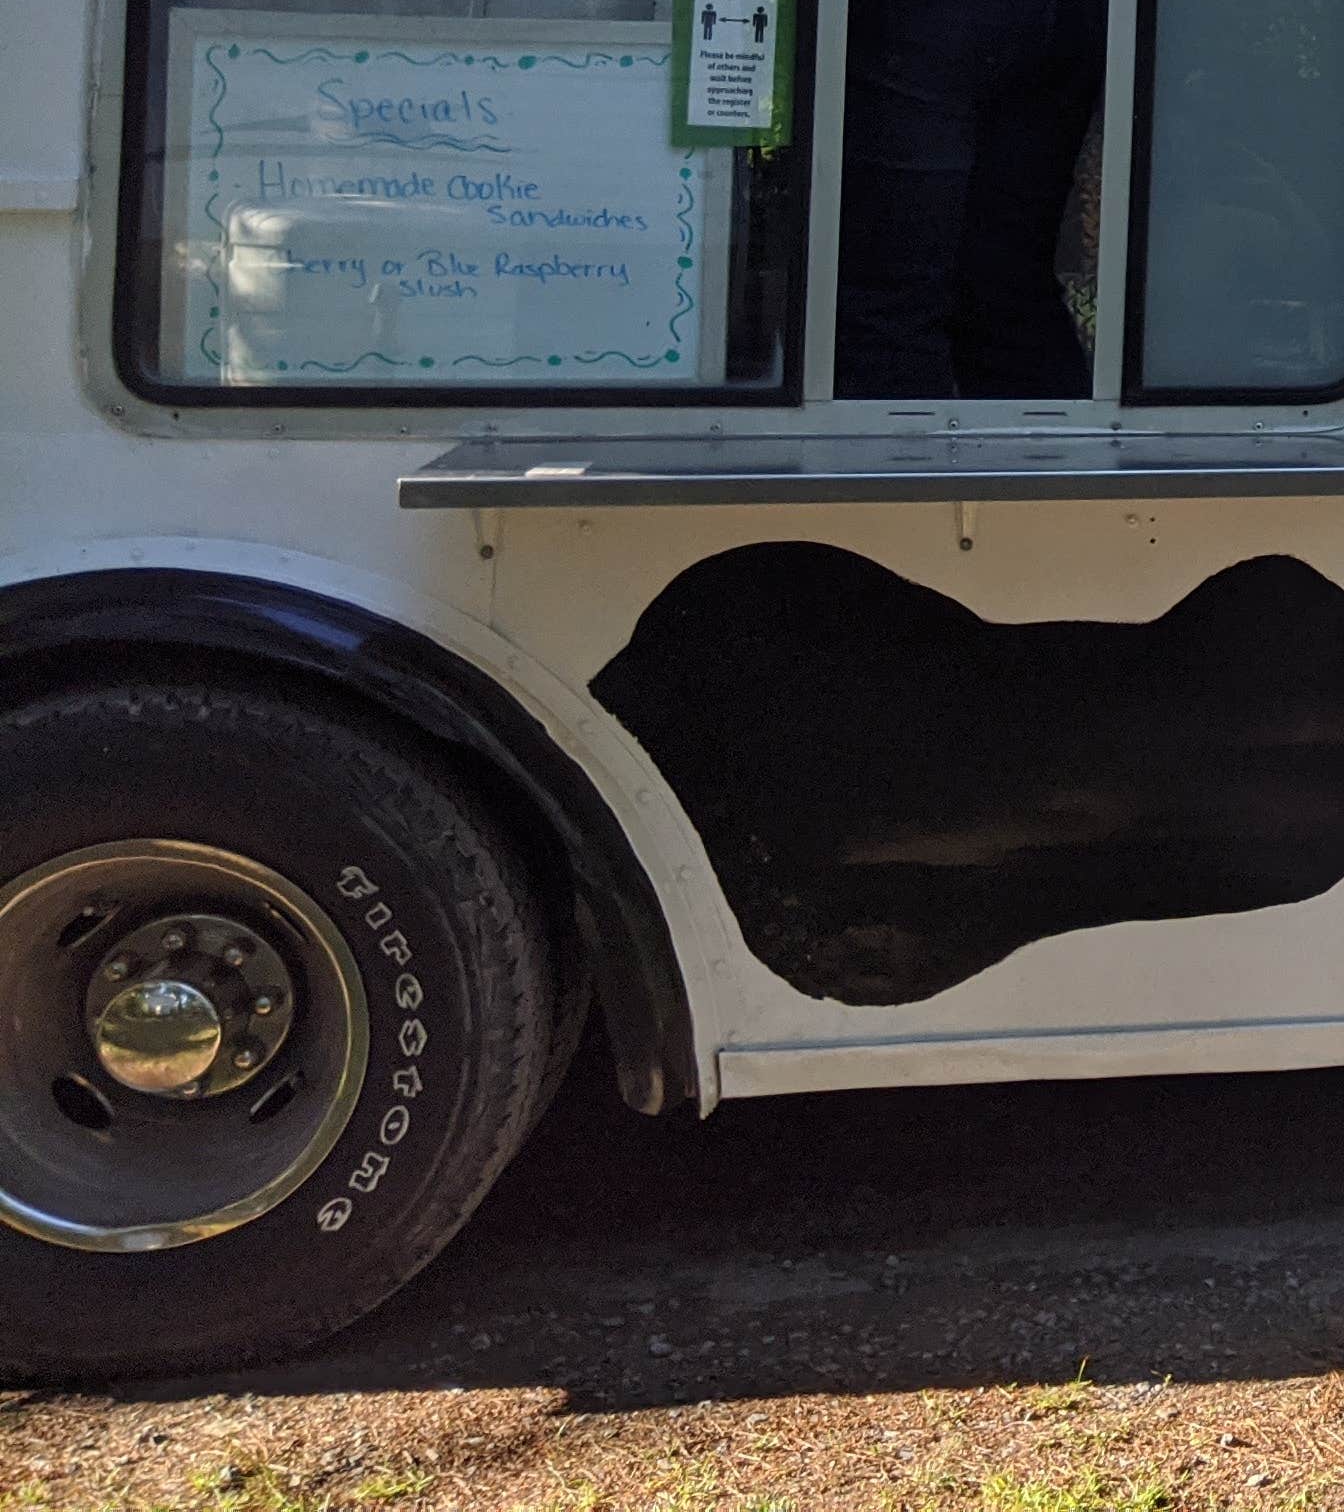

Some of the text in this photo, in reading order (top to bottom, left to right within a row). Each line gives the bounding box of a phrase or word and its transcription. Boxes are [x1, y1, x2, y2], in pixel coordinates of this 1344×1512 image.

[317, 78, 498, 129] Specials
[382, 259, 403, 276] or
[417, 250, 480, 277] Blue
[495, 252, 632, 285] Raspberry
